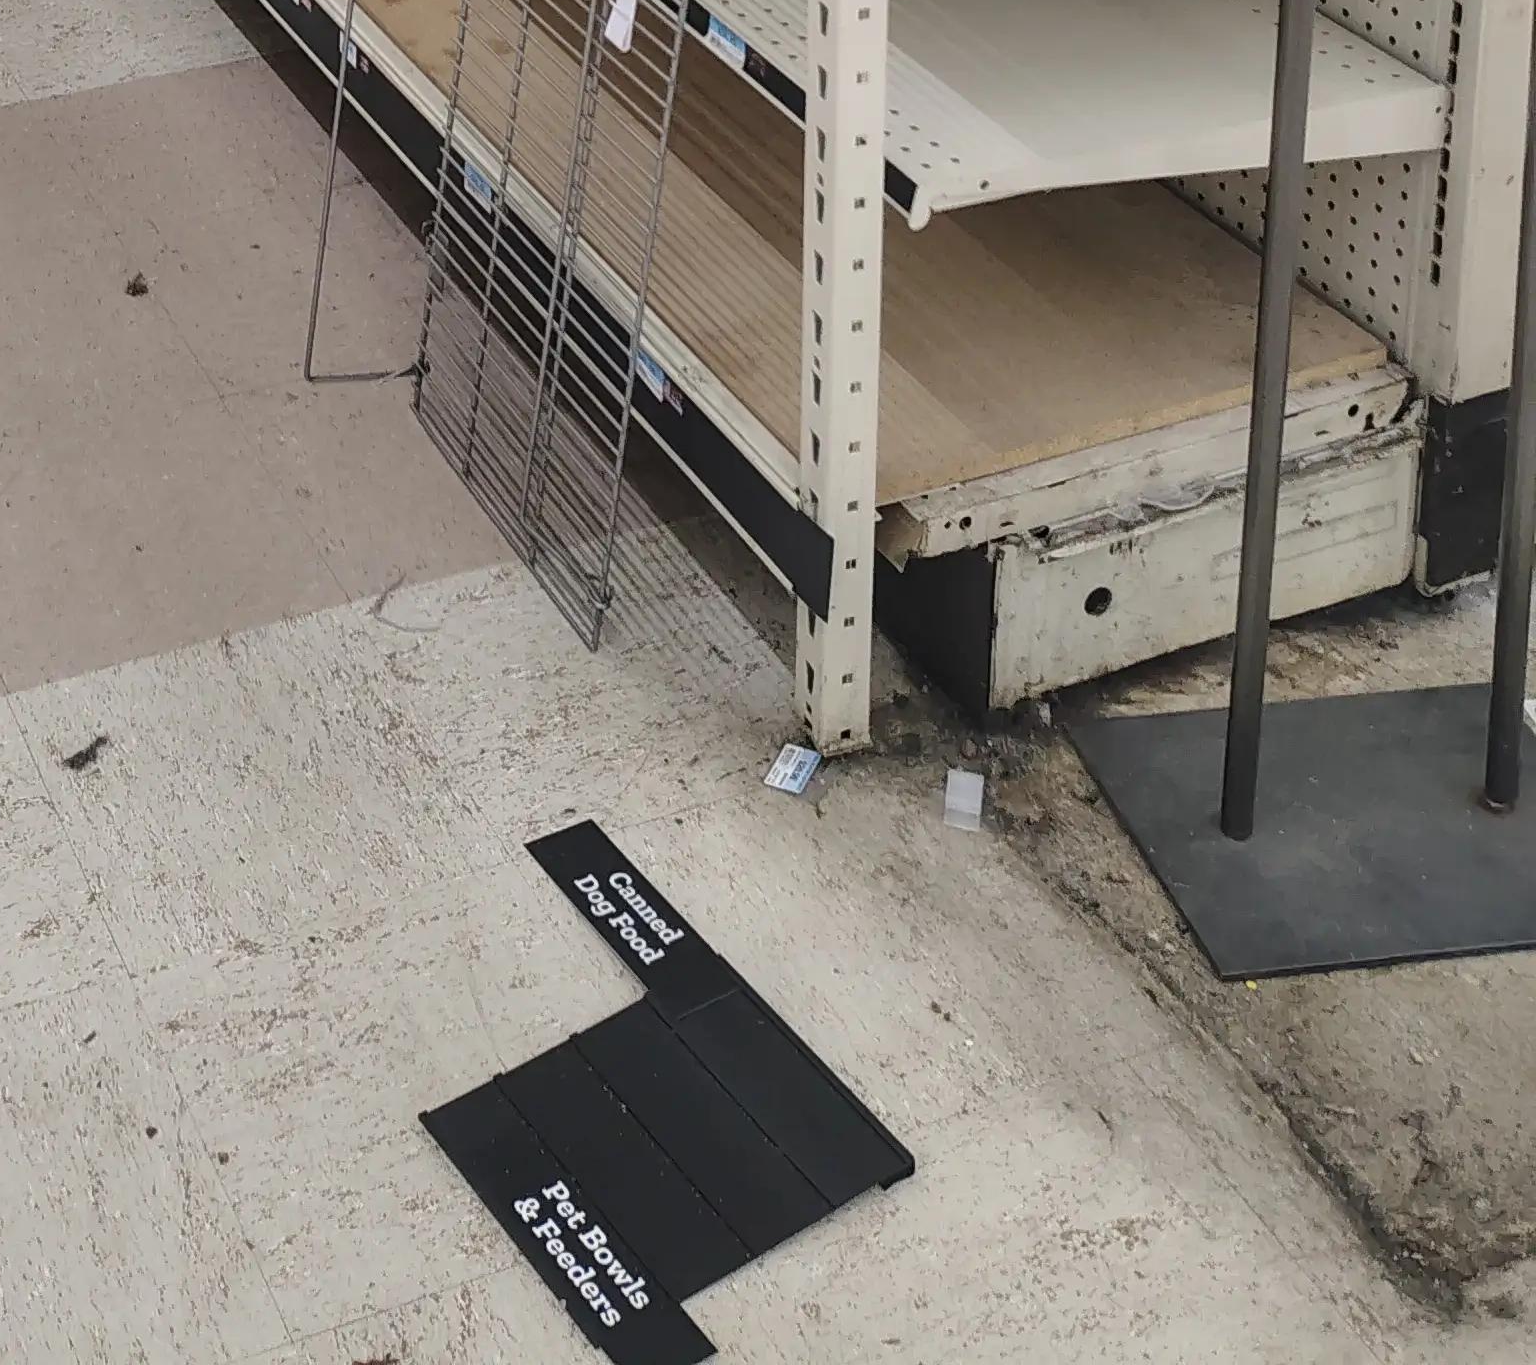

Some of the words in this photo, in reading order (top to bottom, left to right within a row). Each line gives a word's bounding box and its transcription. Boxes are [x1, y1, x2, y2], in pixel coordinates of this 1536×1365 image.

[574, 873, 617, 917] Dog
[608, 911, 665, 966] Food
[609, 872, 685, 945] Canned
[514, 1197, 541, 1223] &
[531, 1218, 622, 1327] Feeders
[541, 1180, 586, 1230] Pet
[577, 1224, 650, 1310] Bowls
